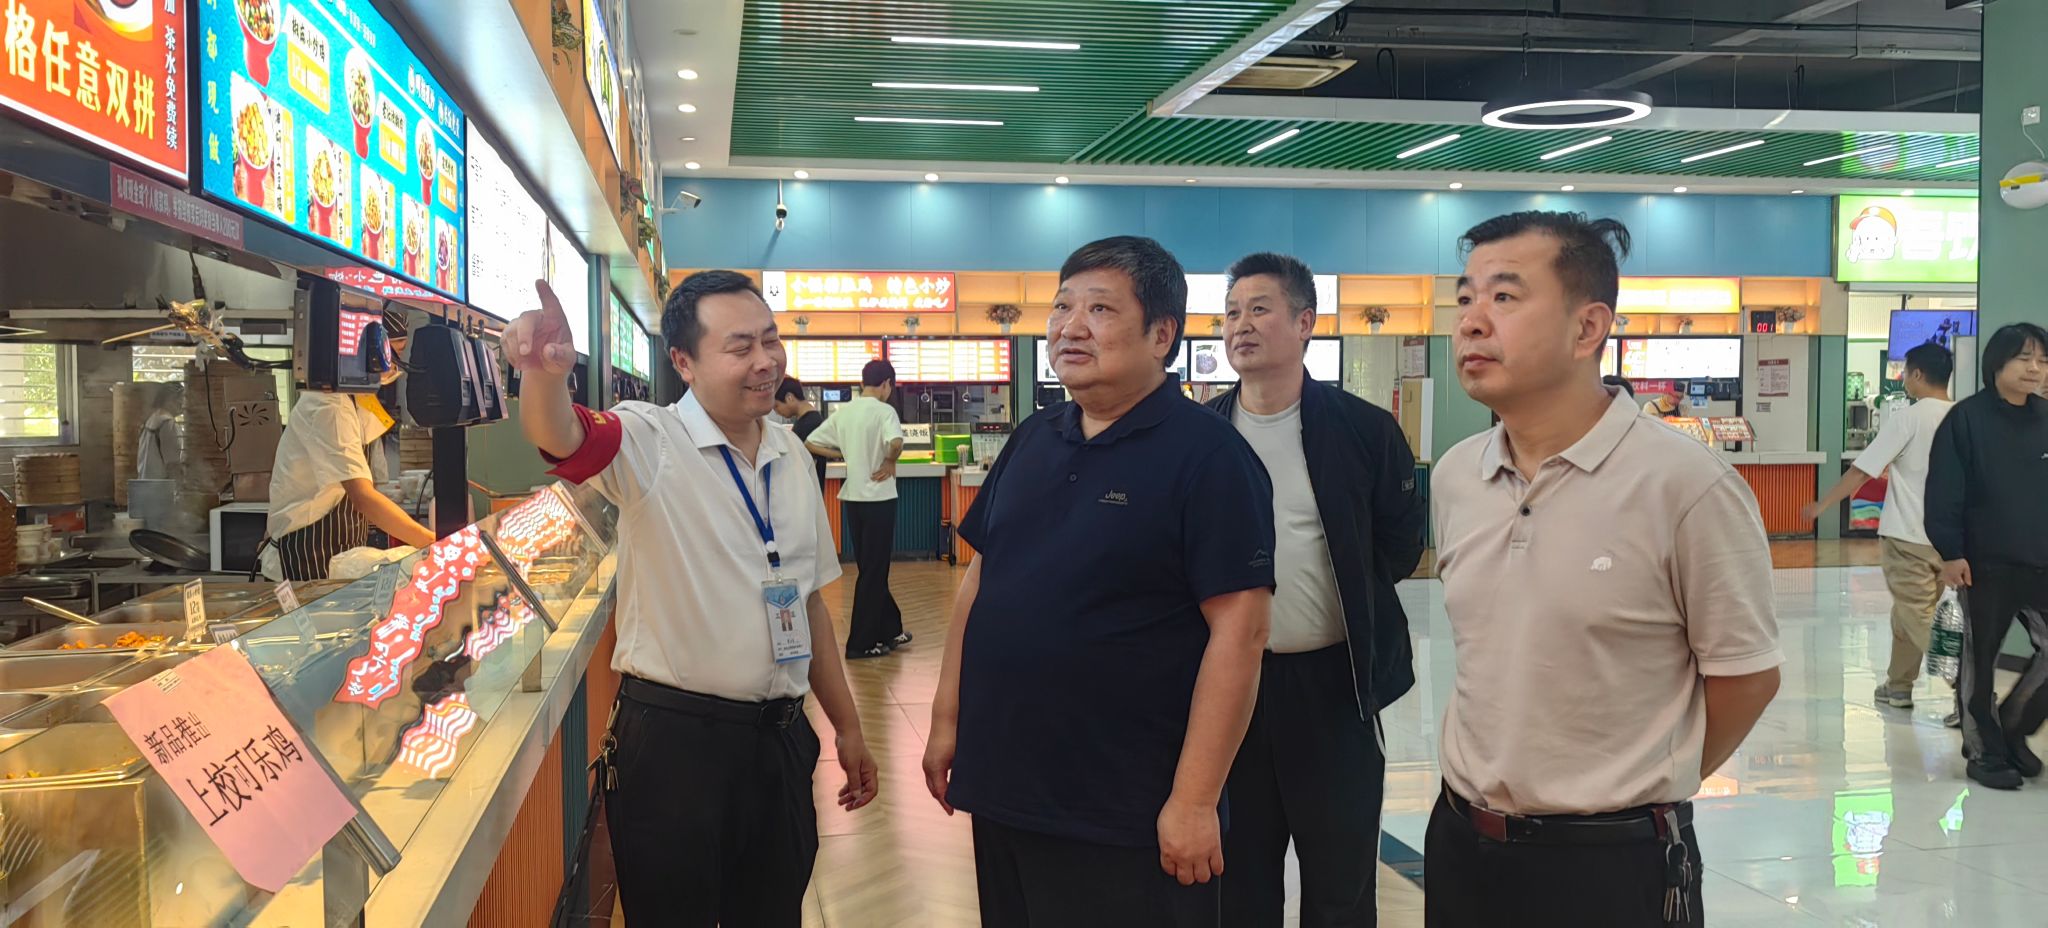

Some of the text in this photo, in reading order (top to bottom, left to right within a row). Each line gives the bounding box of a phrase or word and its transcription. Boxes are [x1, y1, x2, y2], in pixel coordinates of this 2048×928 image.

[4, 0, 155, 139] 格任意双拼
[165, 25, 177, 150] 茶水免费续
[206, 0, 220, 165] 都现做
[1105, 490, 1126, 501] Jeep
[144, 712, 211, 765] 新品推出
[186, 724, 304, 826] 上校可乐鸡
